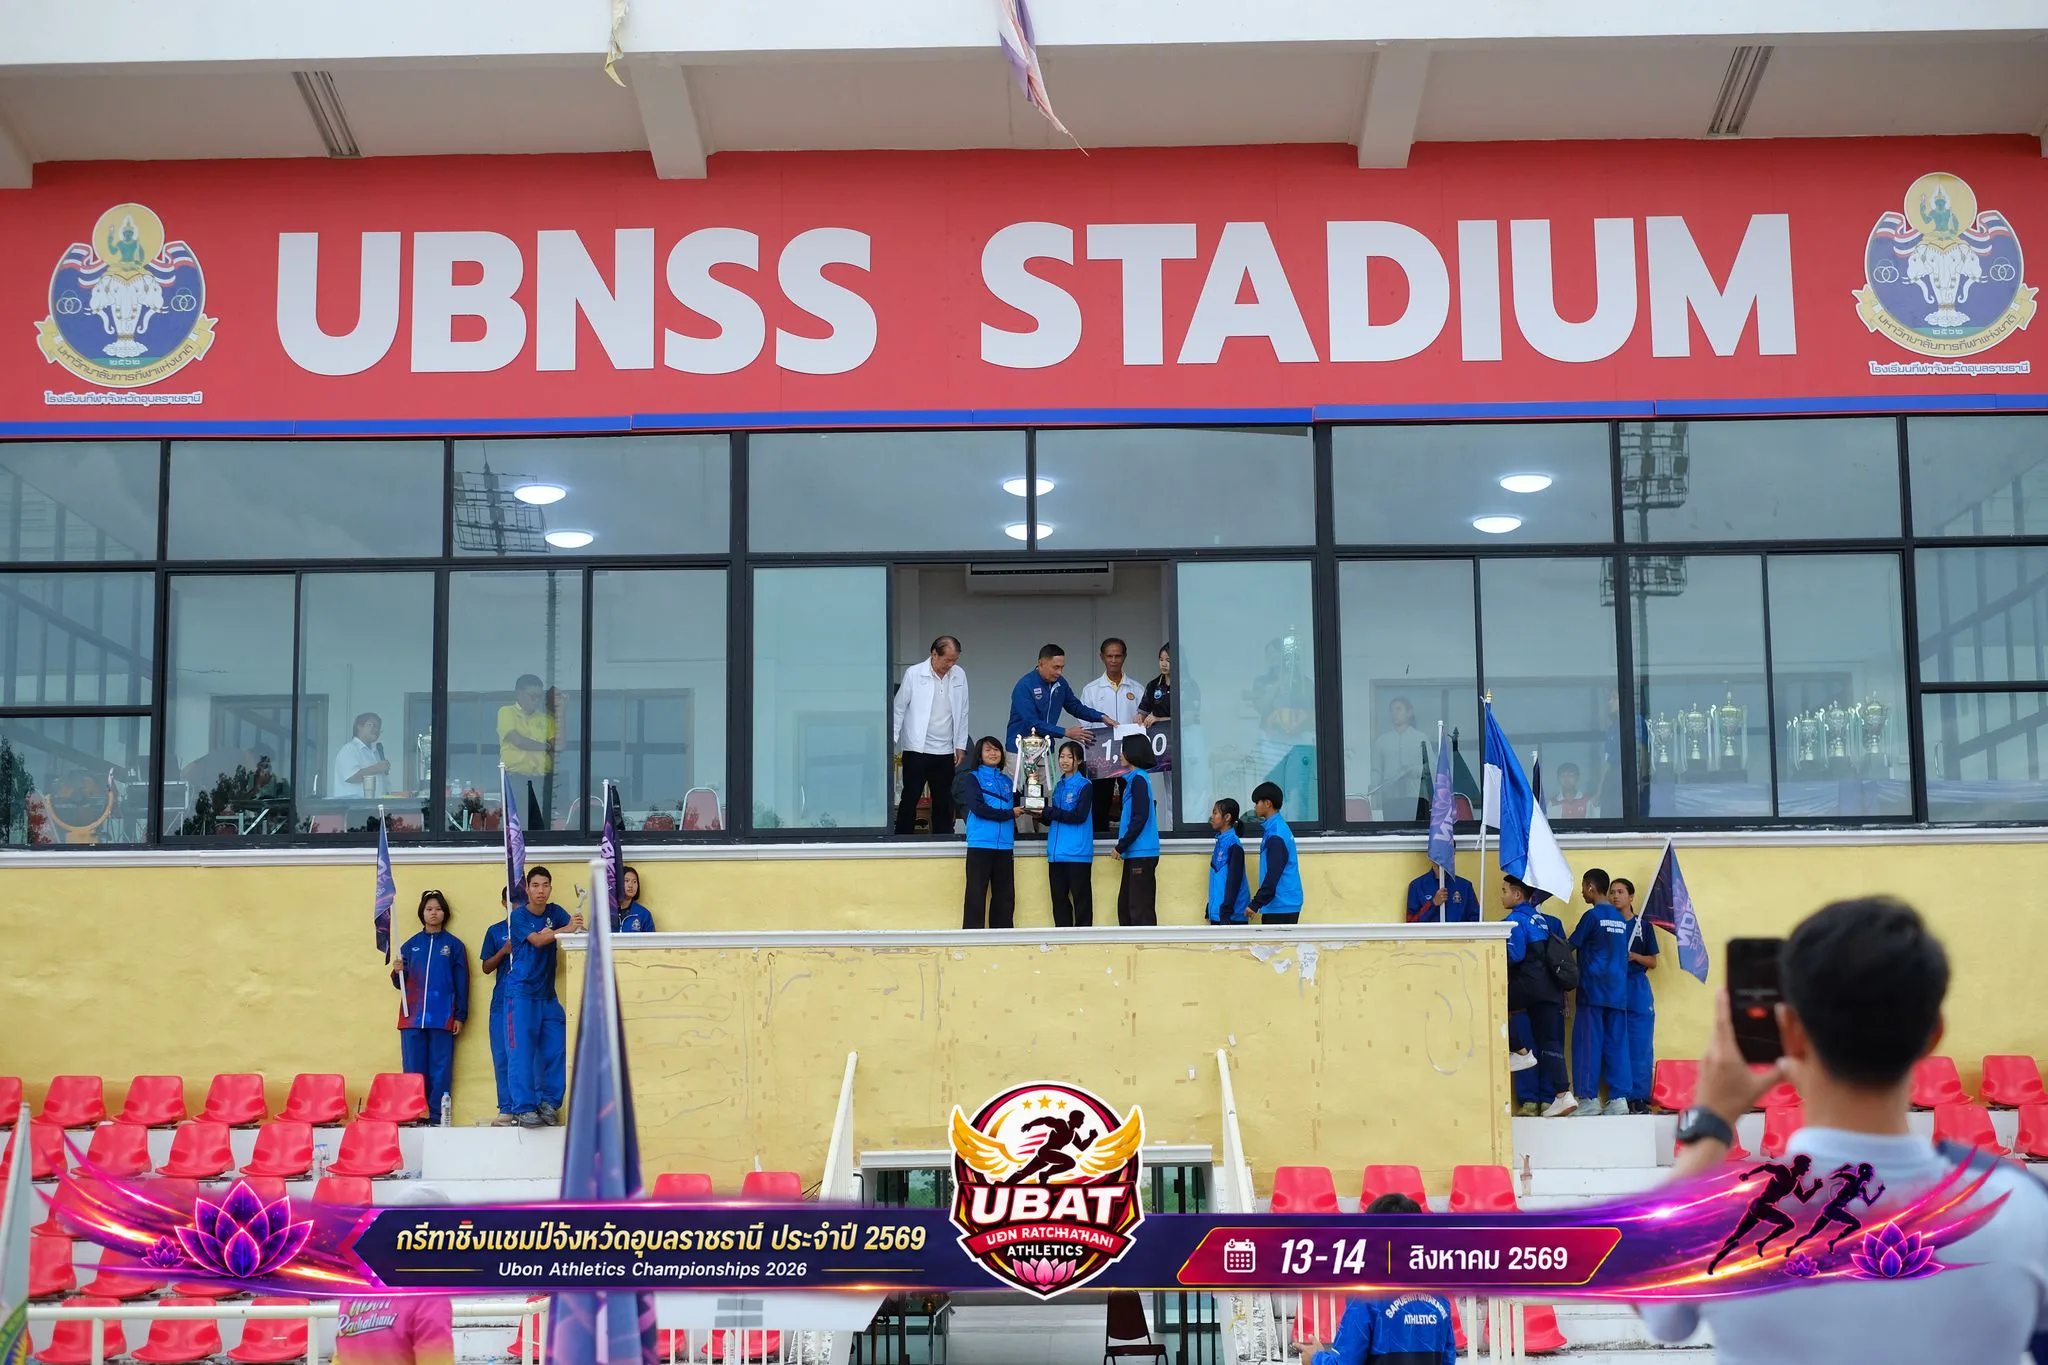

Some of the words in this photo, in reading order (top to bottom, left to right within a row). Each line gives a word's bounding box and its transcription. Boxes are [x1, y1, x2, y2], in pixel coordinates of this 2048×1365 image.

[277, 228, 878, 376] UBNSS
[980, 213, 1798, 368] STADIUM
[1101, 733, 1167, 764] 1,0
[1403, 1313, 1438, 1325] ATHLETICS
